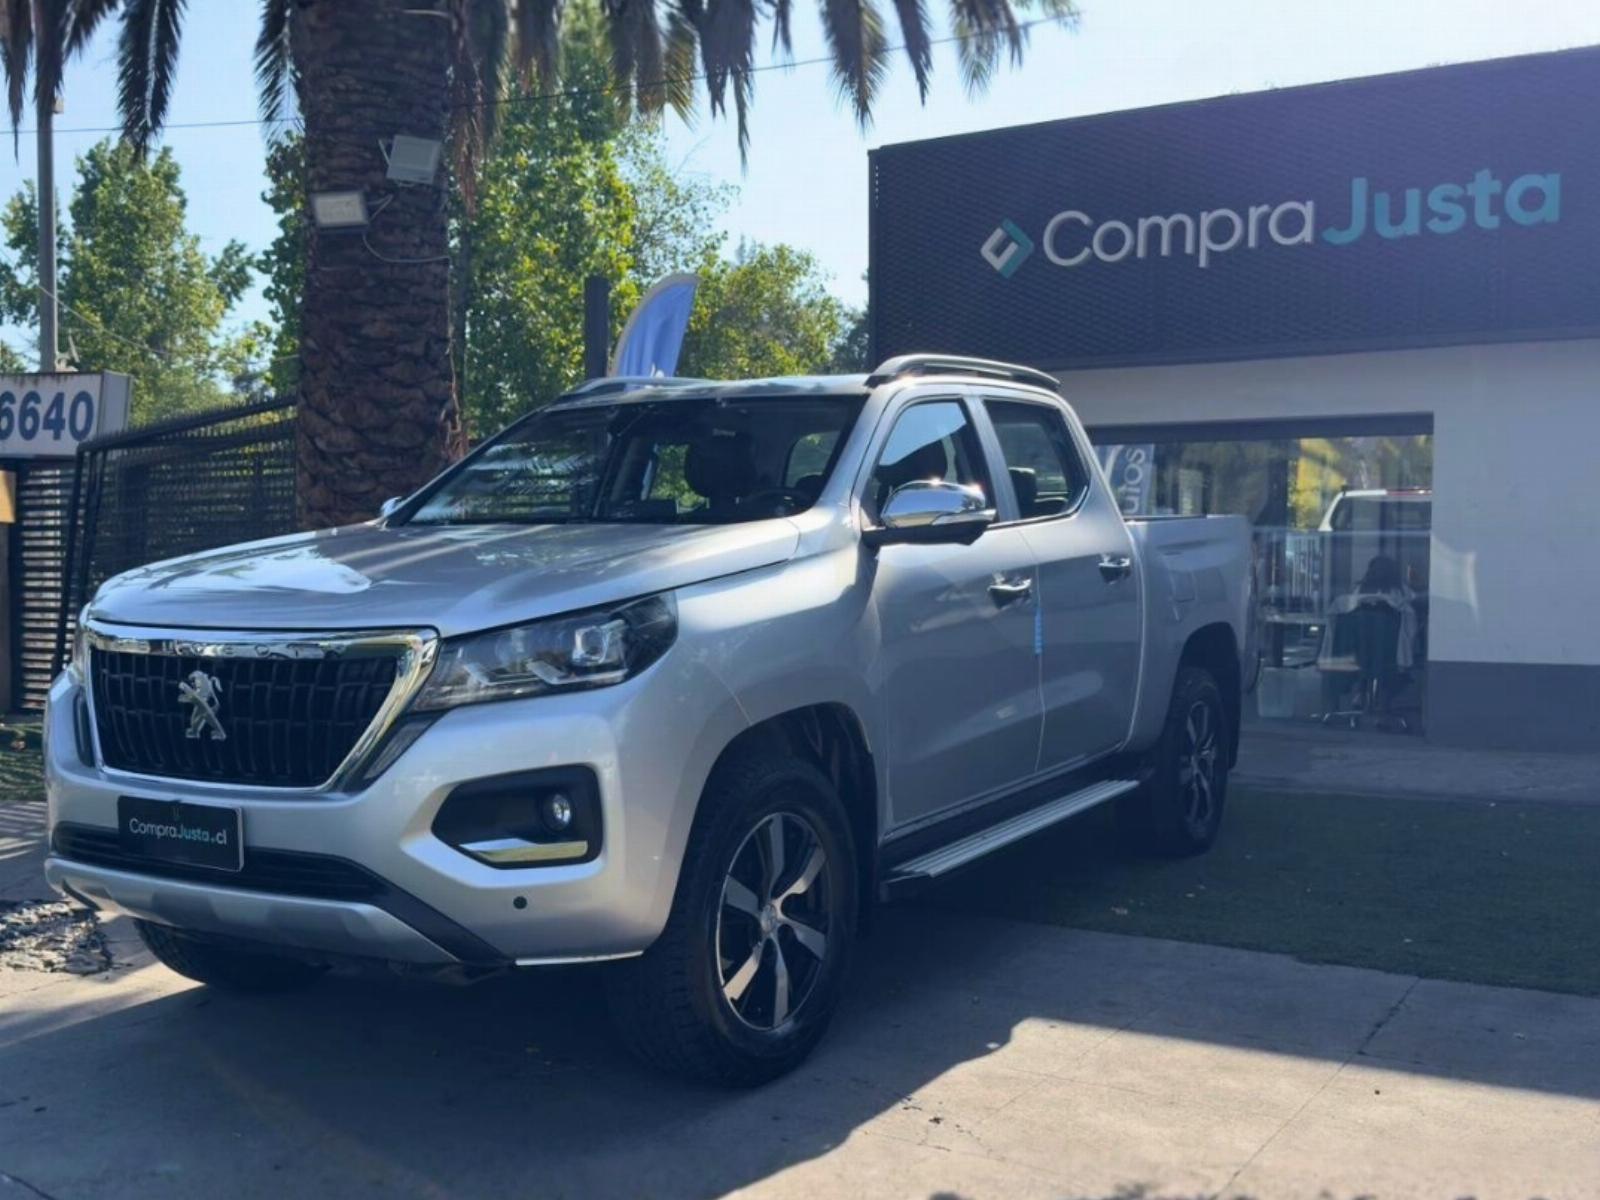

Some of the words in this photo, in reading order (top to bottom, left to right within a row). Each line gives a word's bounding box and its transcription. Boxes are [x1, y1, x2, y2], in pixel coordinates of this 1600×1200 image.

[1043, 200, 1314, 268] Compra
[1322, 168, 1562, 245] Justa
[0, 390, 95, 441] 6640
[1117, 447, 1146, 514] utos
